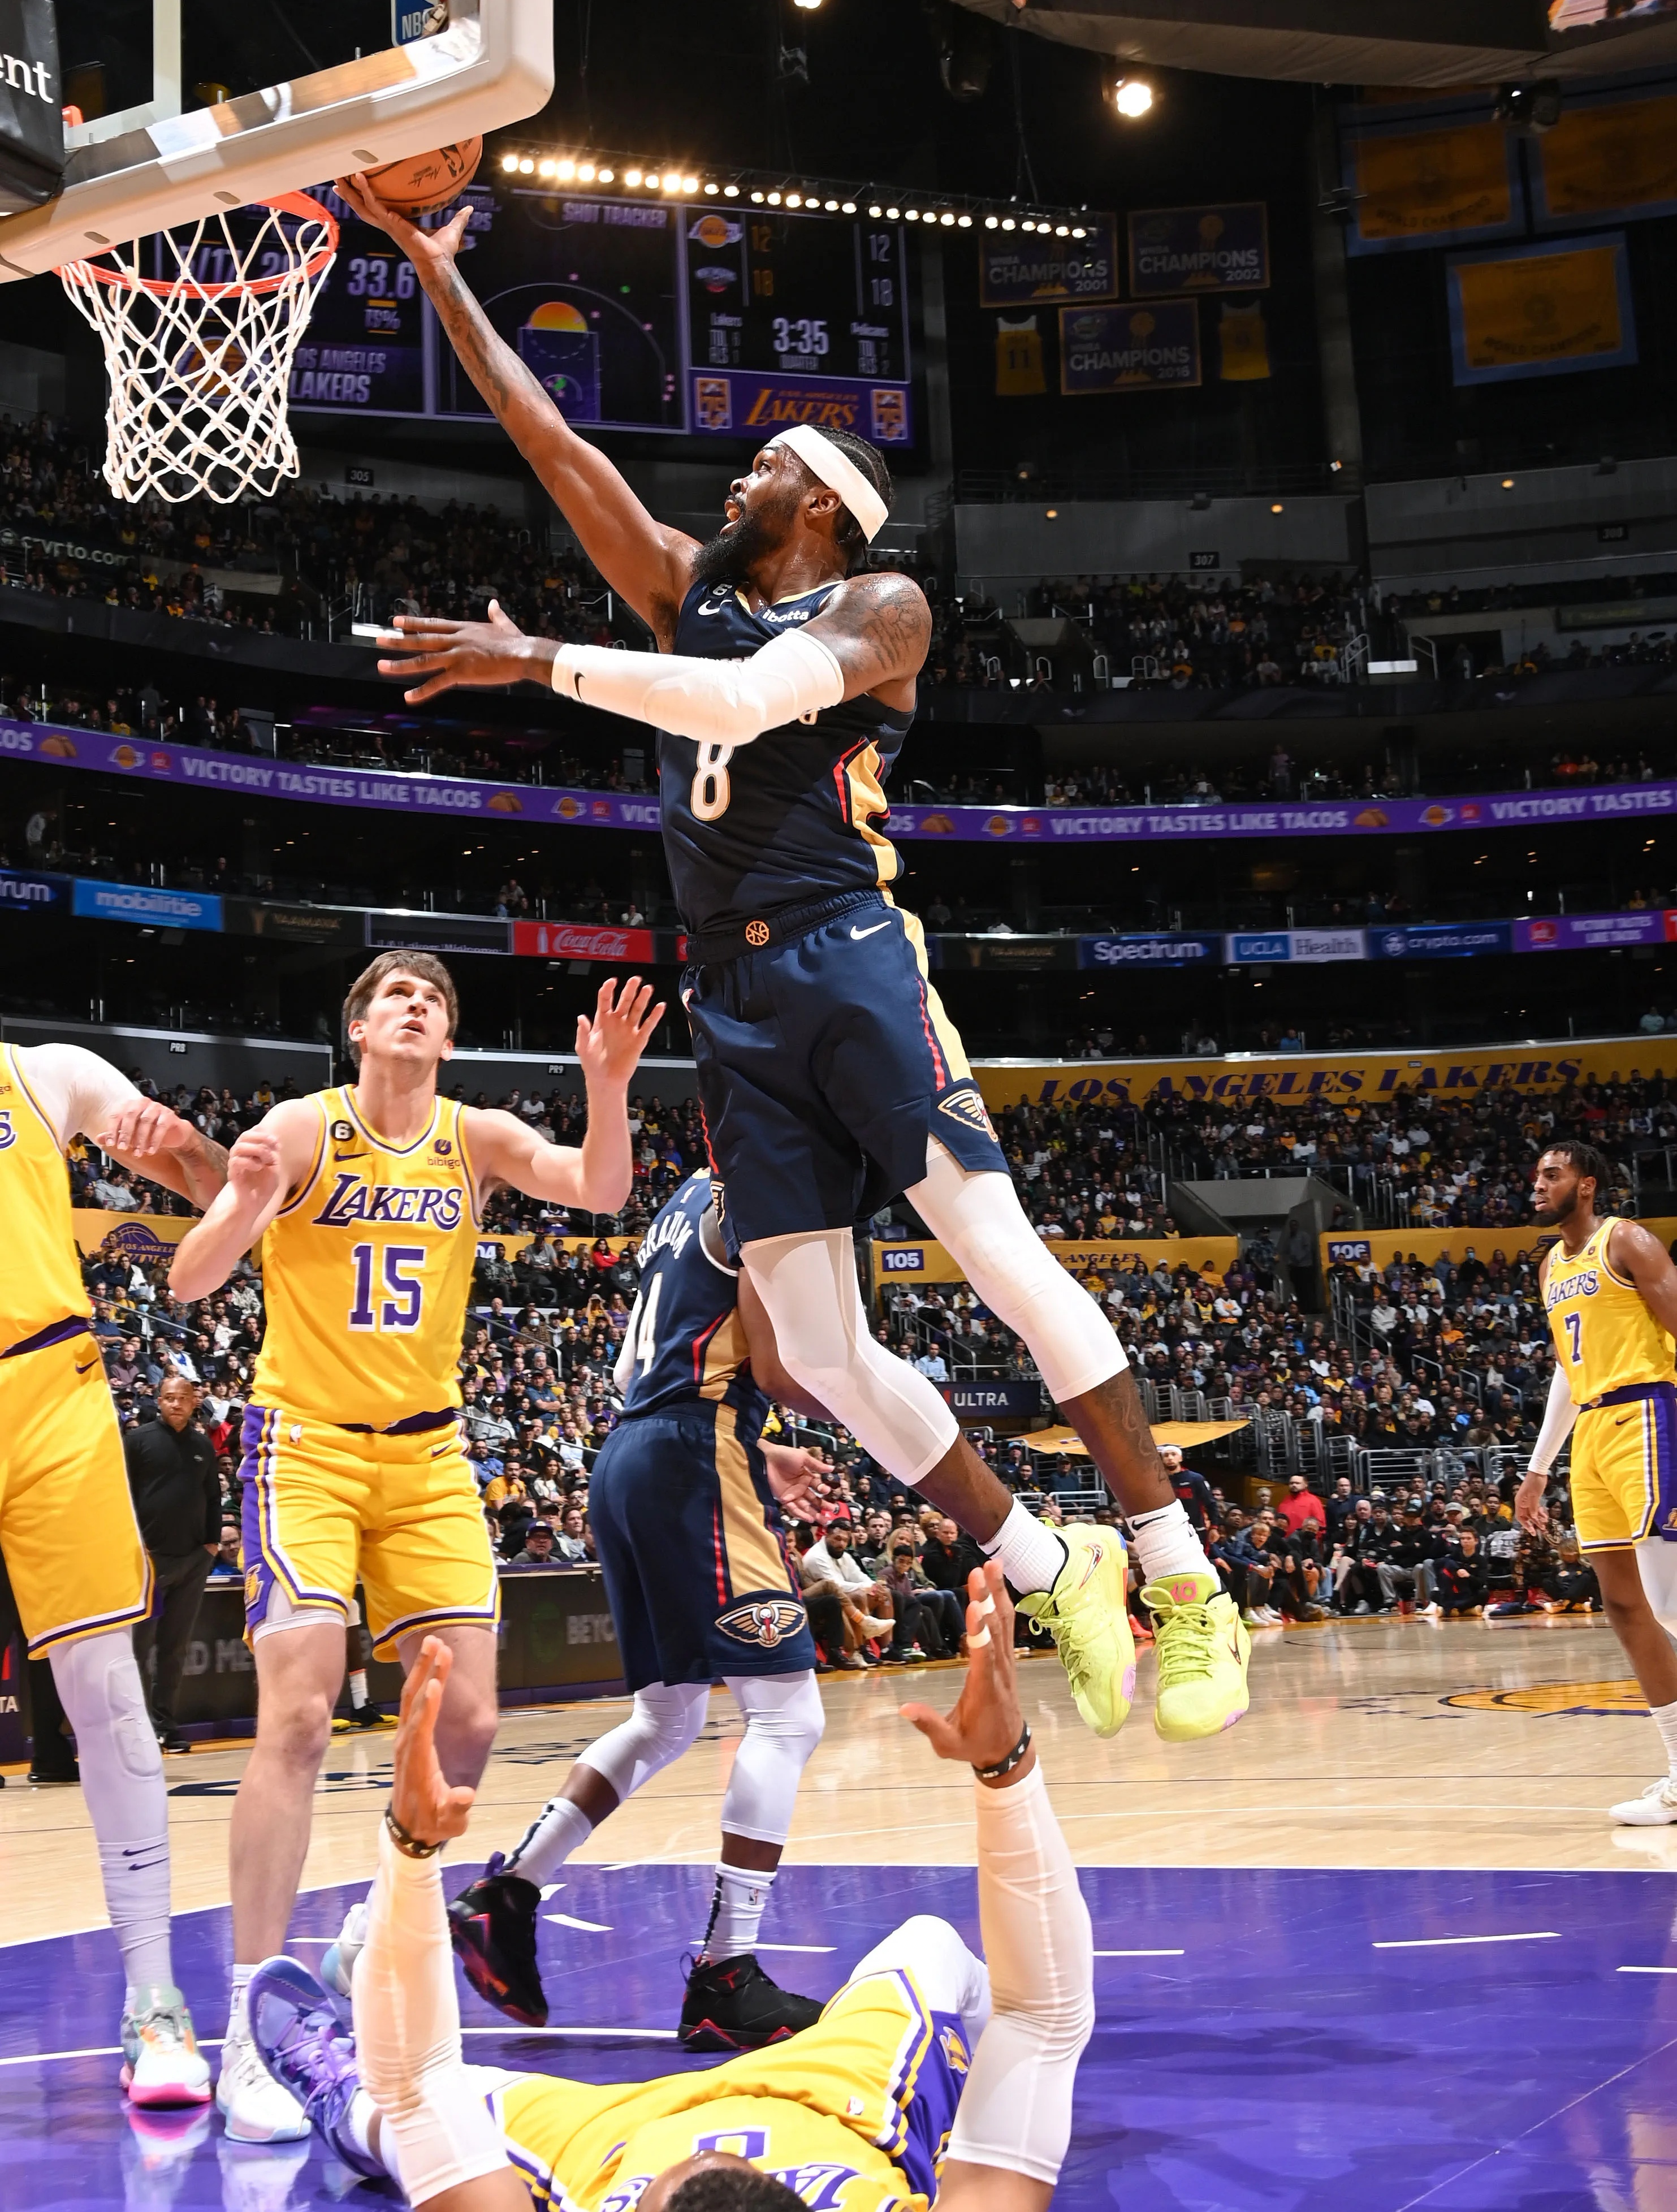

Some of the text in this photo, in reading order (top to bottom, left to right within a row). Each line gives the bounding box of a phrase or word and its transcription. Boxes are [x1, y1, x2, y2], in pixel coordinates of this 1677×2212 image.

[562, 202, 667, 228] SHOT TRACKER
[868, 234, 891, 262] 12
[1138, 248, 1260, 274] CHAMPIONS
[348, 258, 416, 300] 33.6
[989, 258, 1109, 285] CHAMPIONS
[1225, 268, 1261, 282] 2002
[1075, 279, 1108, 292] 2001
[772, 317, 829, 355] 3:35
[322, 350, 387, 374] ANGELES
[1008, 350, 1029, 370] 11
[1069, 346, 1191, 373] CHAMPIONS
[290, 370, 371, 403] LAKERS
[742, 388, 859, 428] LAKERS
[350, 469, 370, 482] 305
[1194, 554, 1214, 566] 307
[712, 583, 733, 596] 6
[762, 608, 810, 623] ibotta
[181, 757, 482, 809] VICTORY TASTES LIKE TACOS
[690, 741, 735, 822] 8
[1490, 790, 1672, 820] VICTORY TASTES
[1050, 810, 1348, 836] VICTORY TASTES LIKE TACOS
[1093, 939, 1203, 964] Spectrum
[1239, 937, 1358, 956] UCLA Health
[1408, 933, 1498, 950] crypto.com
[548, 1065, 564, 1074] PR9
[1036, 1057, 1583, 1103] LOS ANGELES LAKERS
[336, 1122, 349, 1139] 6
[312, 1172, 464, 1232] LAKERS
[885, 1252, 920, 1269] 105
[1063, 1252, 1143, 1263] ANGELES
[348, 1242, 427, 1334] 15
[1546, 1269, 1600, 1313] LAKERS
[1564, 1311, 1583, 1366] 7
[954, 1392, 1010, 1407] ULTRA
